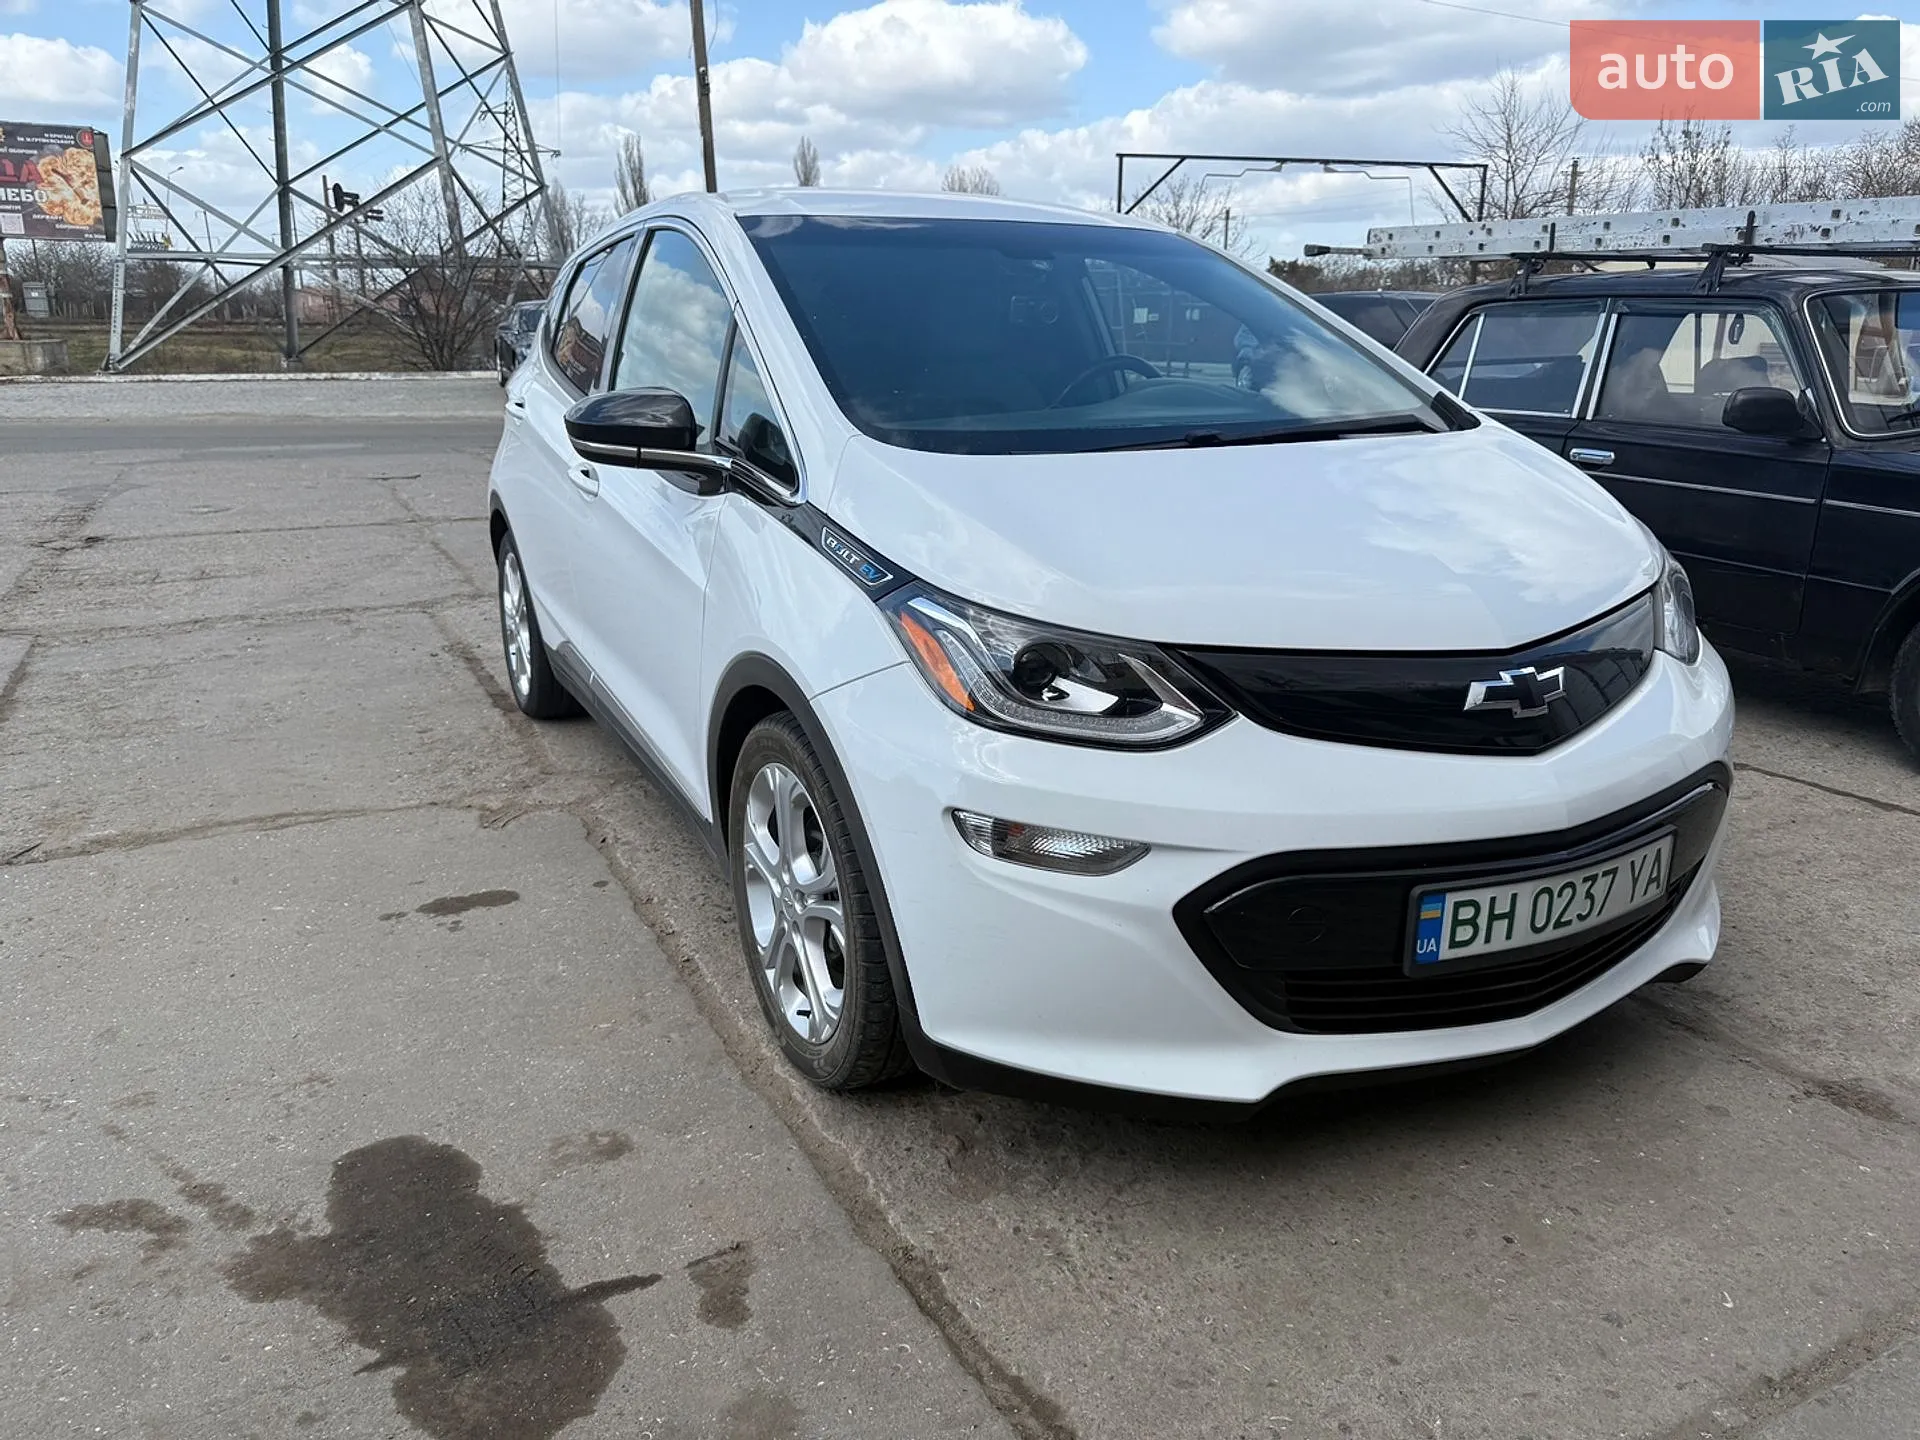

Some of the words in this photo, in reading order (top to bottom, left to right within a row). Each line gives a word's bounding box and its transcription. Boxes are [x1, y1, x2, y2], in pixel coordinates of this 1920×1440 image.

[826, 536, 860, 564] BOLT
[859, 562, 881, 580] EV
[1448, 891, 1518, 950] BH
[1529, 867, 1618, 934] 0237
[1629, 847, 1663, 905] YA
[1416, 938, 1437, 954] UA
